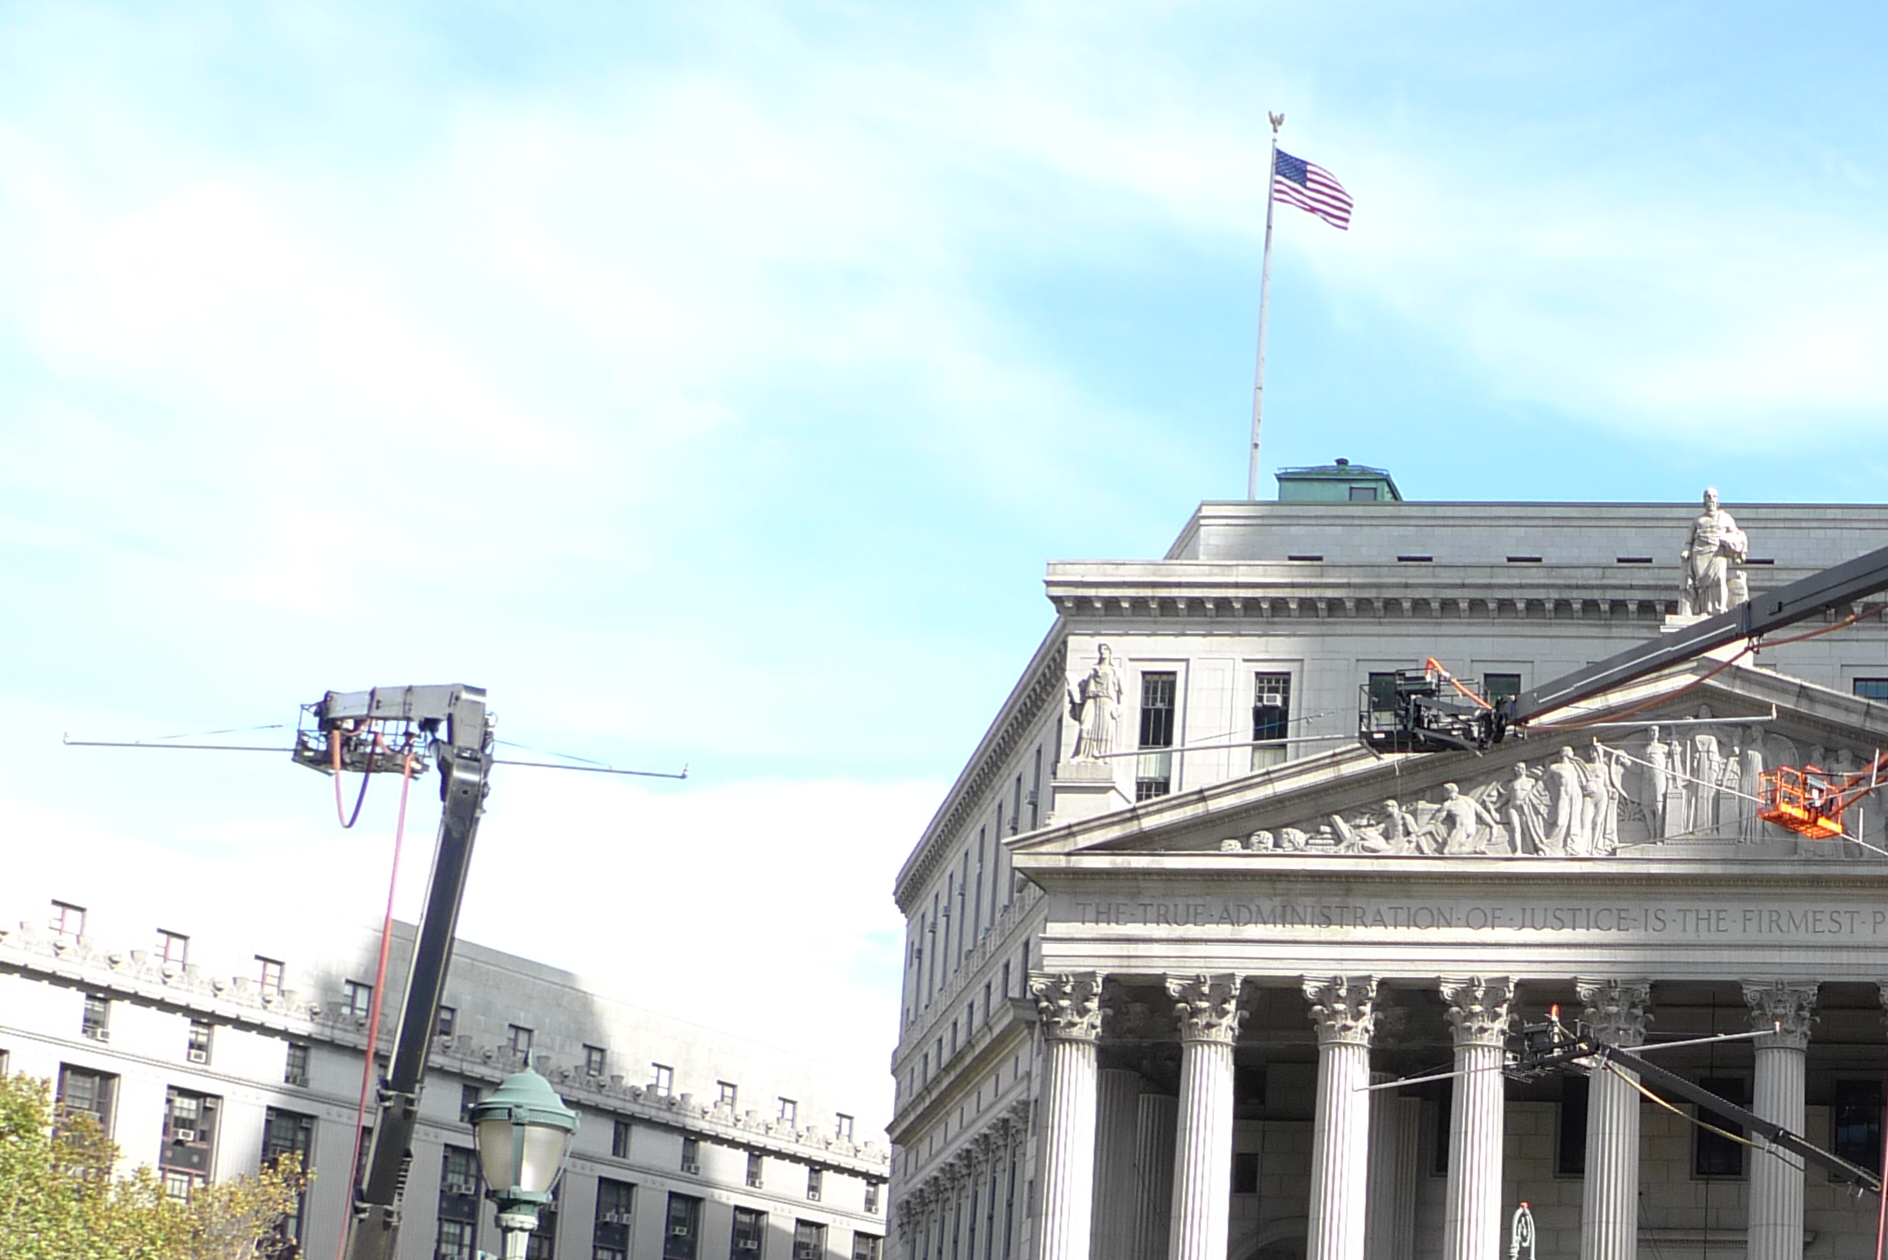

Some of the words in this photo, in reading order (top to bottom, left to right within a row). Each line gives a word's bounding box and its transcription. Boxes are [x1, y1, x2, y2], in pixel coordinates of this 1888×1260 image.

[1076, 902, 1128, 927] THE
[1138, 903, 1206, 929] TRUE
[1216, 903, 1454, 931] ADMINISTRATION
[1466, 907, 1503, 930] OF
[1513, 907, 1630, 932] JUSTICE
[1643, 908, 1668, 933] IS
[1677, 908, 1729, 934] THE
[1742, 909, 1860, 935] FIRMEST
